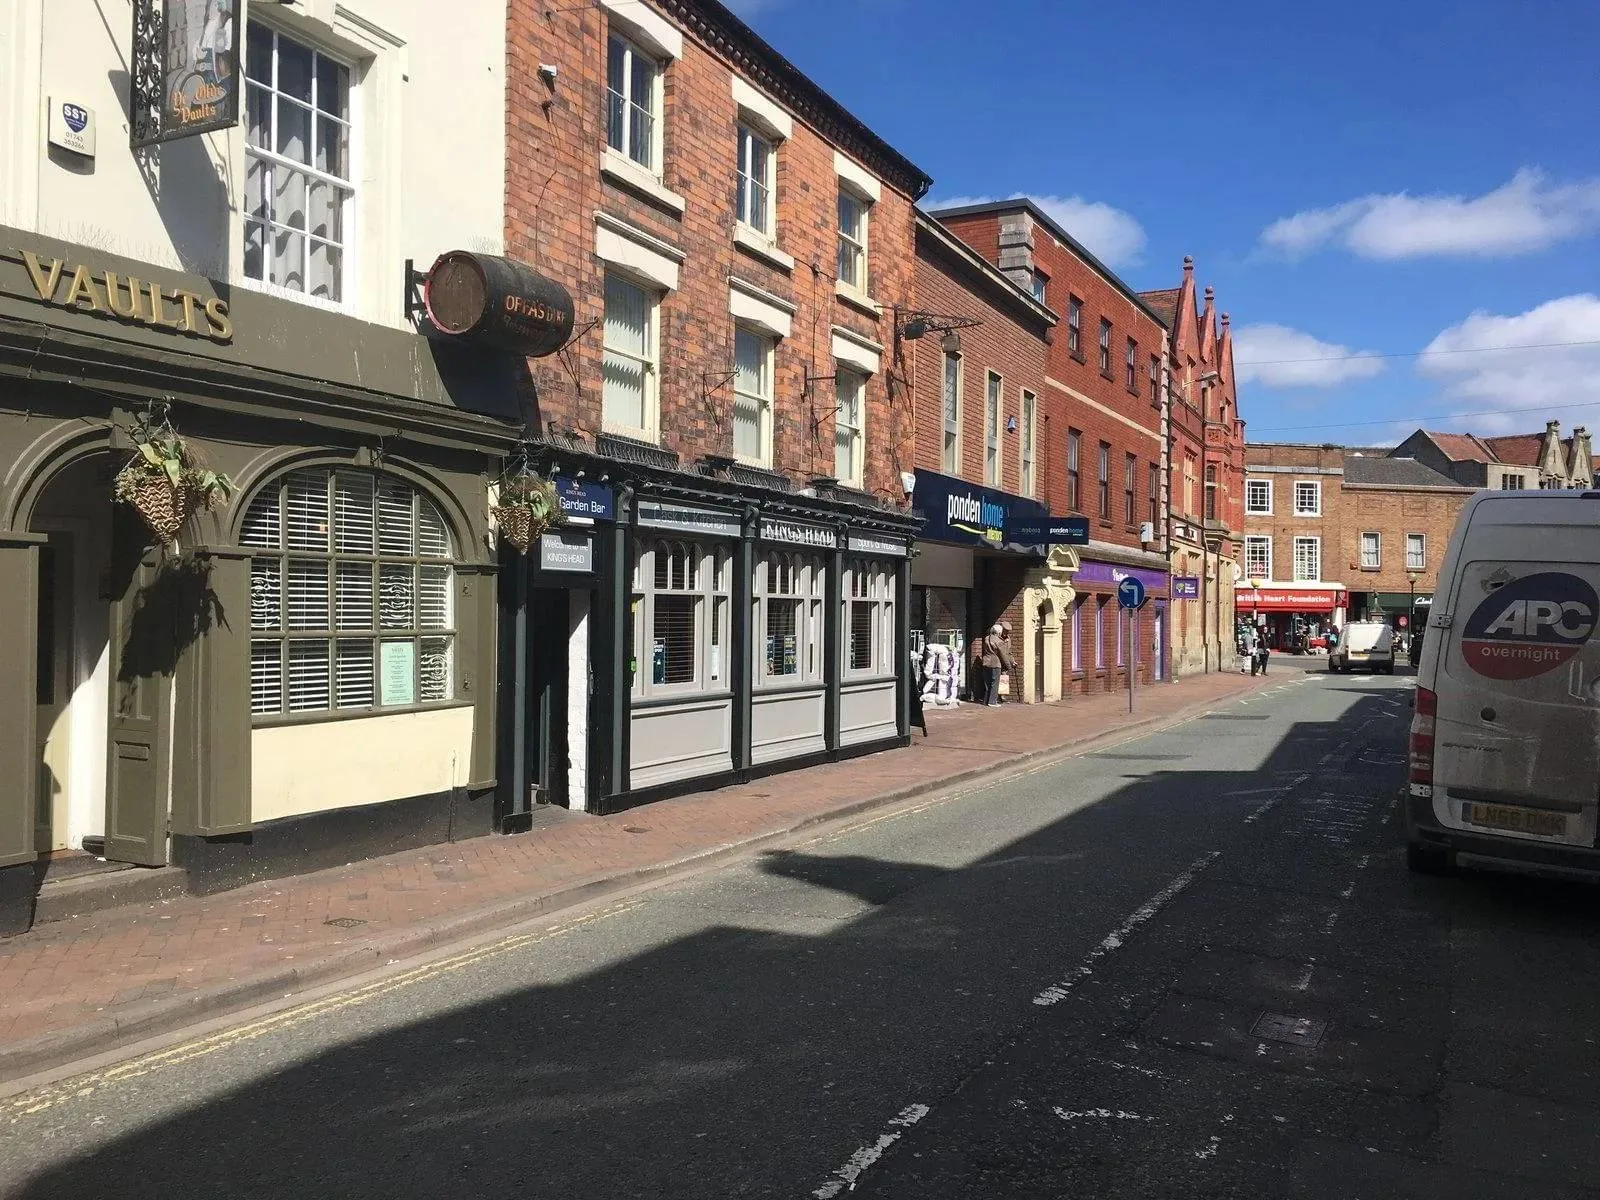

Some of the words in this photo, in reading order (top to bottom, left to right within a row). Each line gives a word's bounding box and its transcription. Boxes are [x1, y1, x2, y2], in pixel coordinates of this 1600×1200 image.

[63, 104, 87, 122] SST
[173, 103, 216, 124] Vaults
[19, 250, 233, 341] VAULTS
[560, 496, 589, 512] Garden
[591, 501, 606, 514] Bar
[947, 492, 980, 524] ponden
[981, 495, 1004, 528] home
[653, 505, 678, 524] Cask
[681, 509, 690, 525] &
[692, 511, 727, 530] Kitchen
[805, 527, 834, 546] HEAD
[568, 554, 585, 564] HEAD
[1236, 595, 1262, 603] Britih
[1263, 595, 1286, 603] Heart
[1287, 595, 1331, 603] Foundation
[1484, 599, 1592, 639] APC
[1481, 646, 1561, 662] overnight
